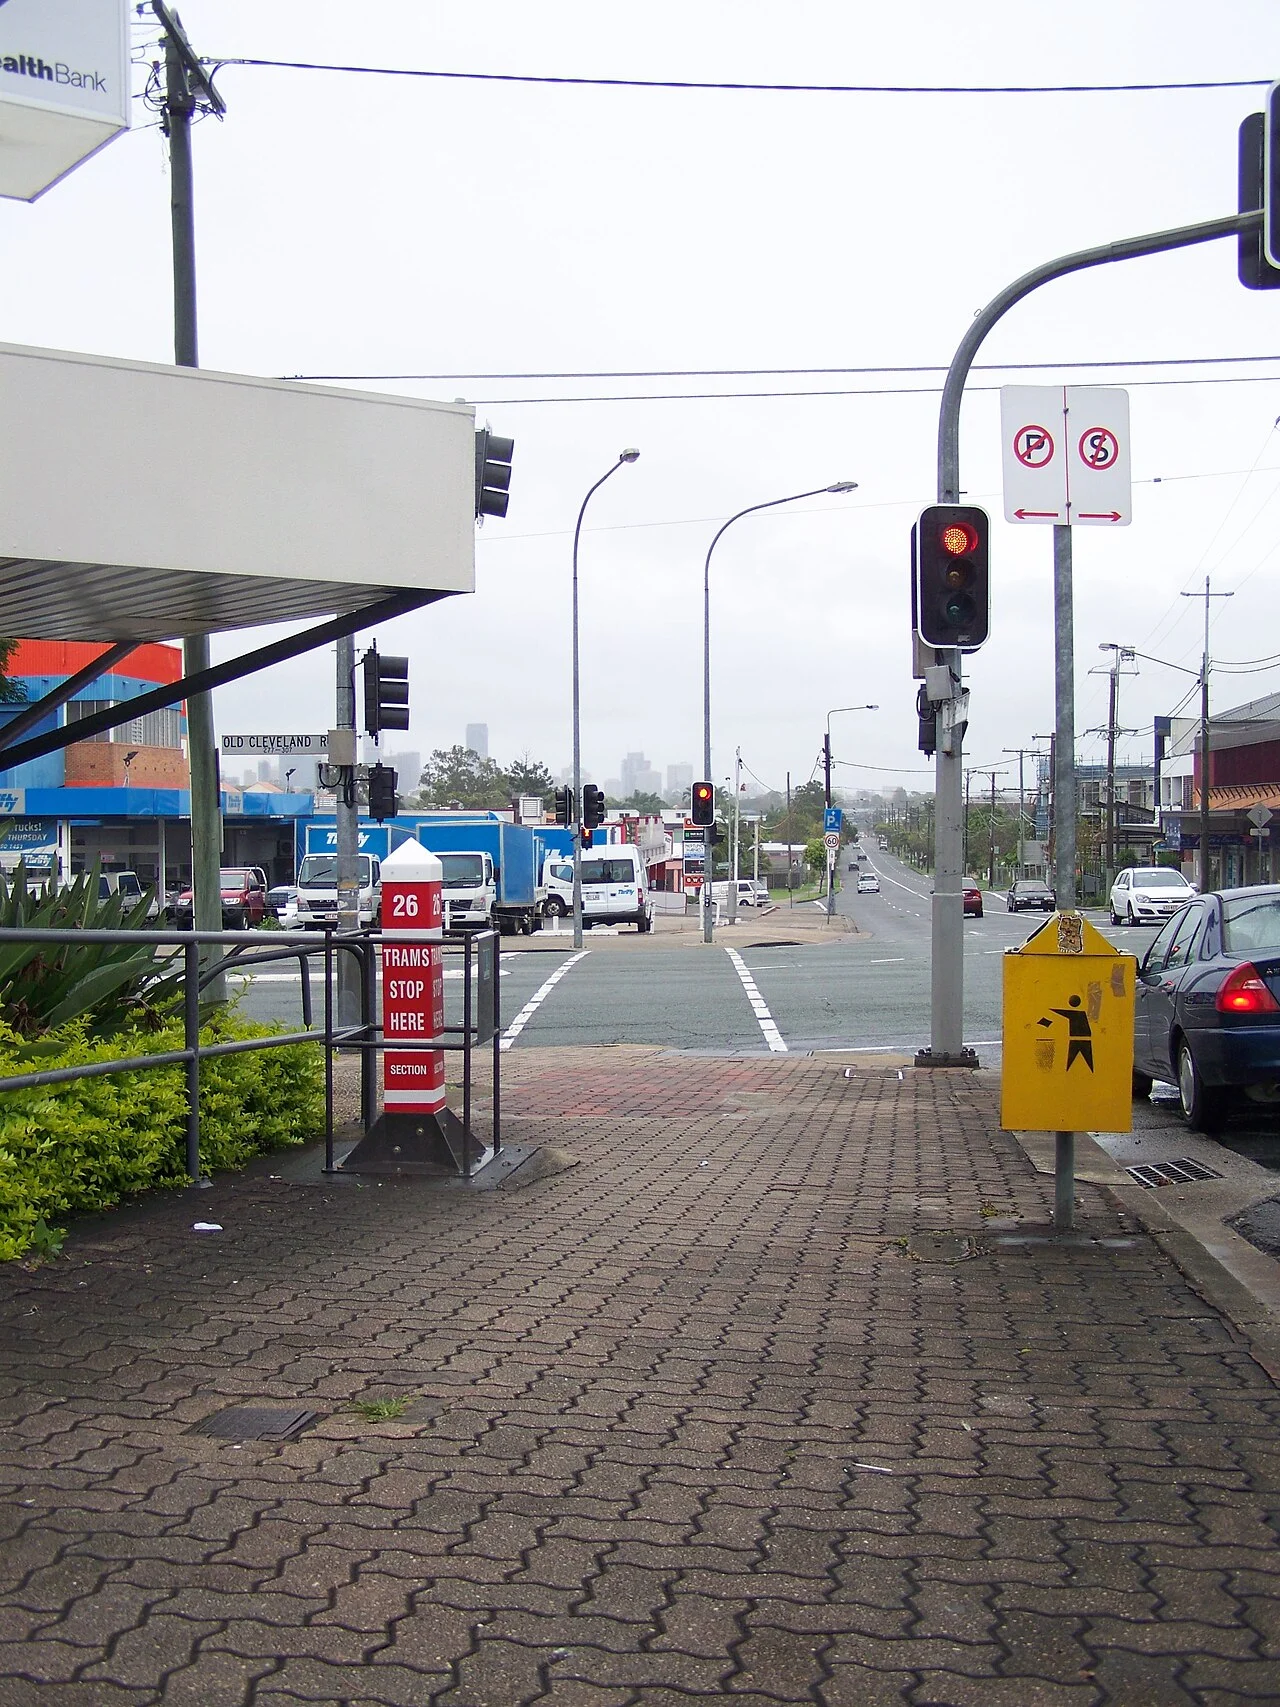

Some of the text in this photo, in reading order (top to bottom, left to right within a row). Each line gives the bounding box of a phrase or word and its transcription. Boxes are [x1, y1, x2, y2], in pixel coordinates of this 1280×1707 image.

[0, 54, 107, 93] althBank
[223, 736, 328, 748] OLD CLEVELAND R
[14, 822, 42, 832] rucks!
[8, 833, 47, 841] THURSDAY
[827, 837, 837, 845] 60
[393, 894, 418, 917] 26
[432, 893, 441, 916] 26
[383, 948, 430, 967] TRAMS
[389, 980, 425, 999] STOP
[390, 1012, 425, 1031] HERE
[390, 1064, 427, 1075] SECTION
